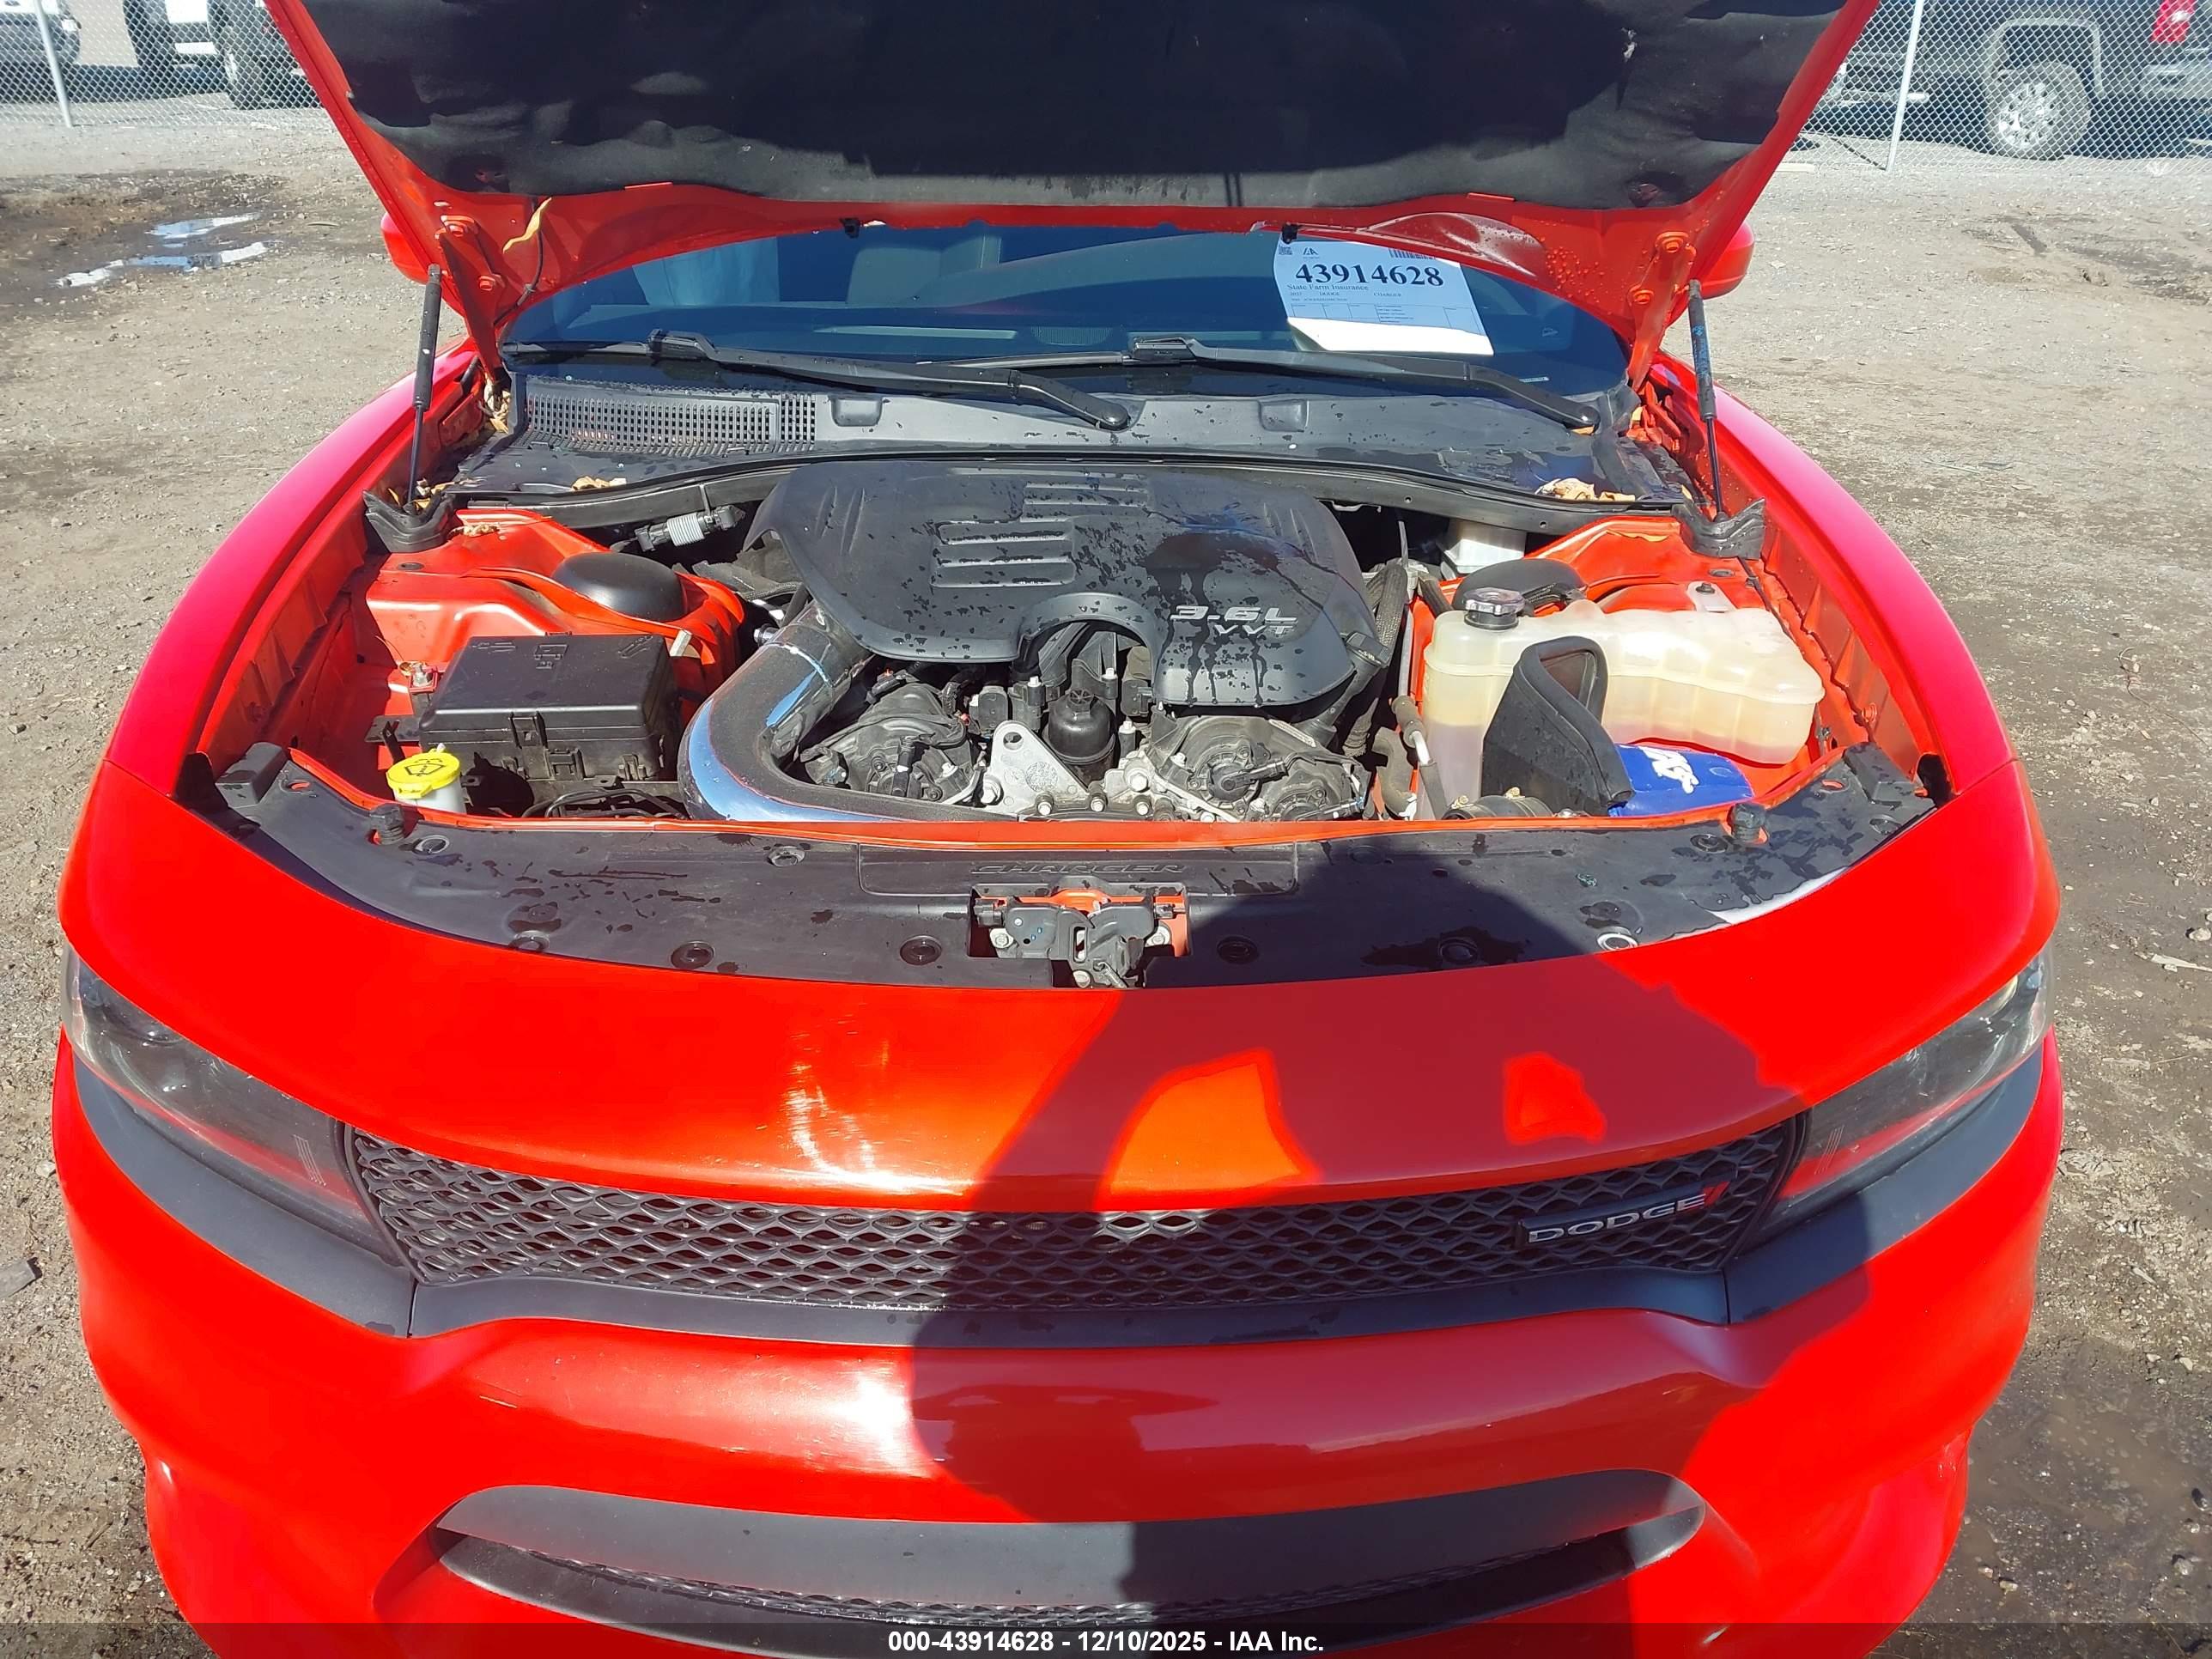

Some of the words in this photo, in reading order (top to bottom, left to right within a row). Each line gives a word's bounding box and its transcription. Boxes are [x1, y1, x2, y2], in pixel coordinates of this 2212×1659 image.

[1295, 264, 1444, 286] 43914628
[1170, 605, 1298, 623] 3.6L
[1214, 624, 1294, 636] VVT
[970, 864, 1188, 874] CHARGER
[1528, 1194, 1706, 1243] DODGE
